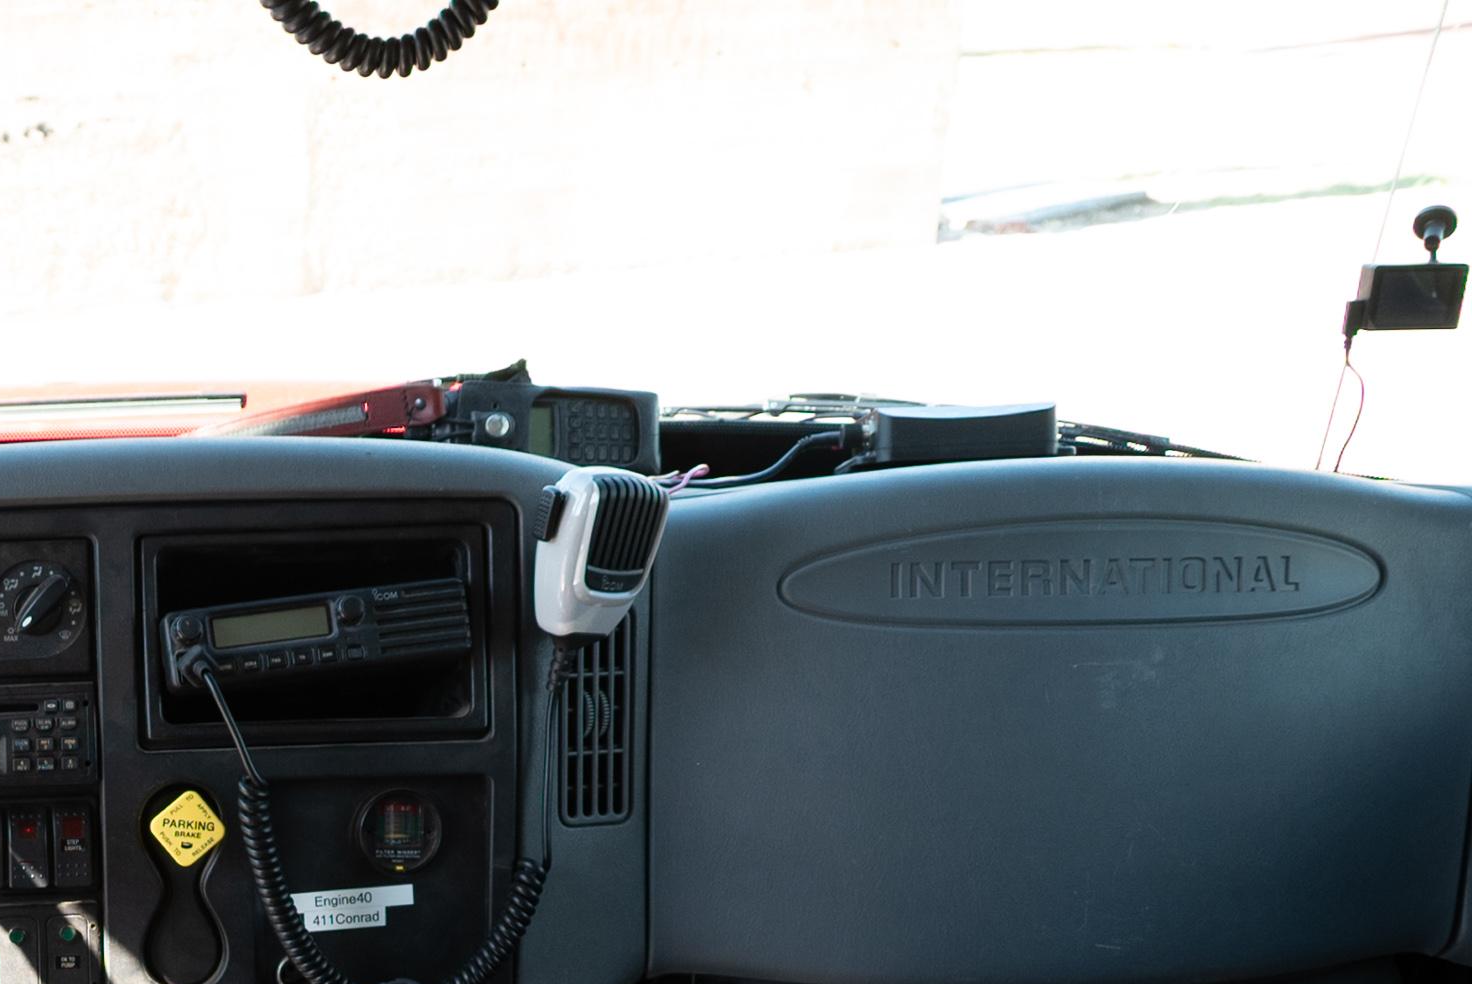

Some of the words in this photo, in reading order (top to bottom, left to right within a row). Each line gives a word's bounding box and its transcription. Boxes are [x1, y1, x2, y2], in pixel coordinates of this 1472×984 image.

[889, 555, 1301, 600] INTERNATIONAL
[170, 803, 183, 815] PULL
[197, 803, 212, 820] APPLY
[162, 817, 215, 832] PARKING
[174, 830, 201, 839] BRAKE
[314, 891, 373, 908] Engine40
[313, 909, 380, 926] 411Conrad
